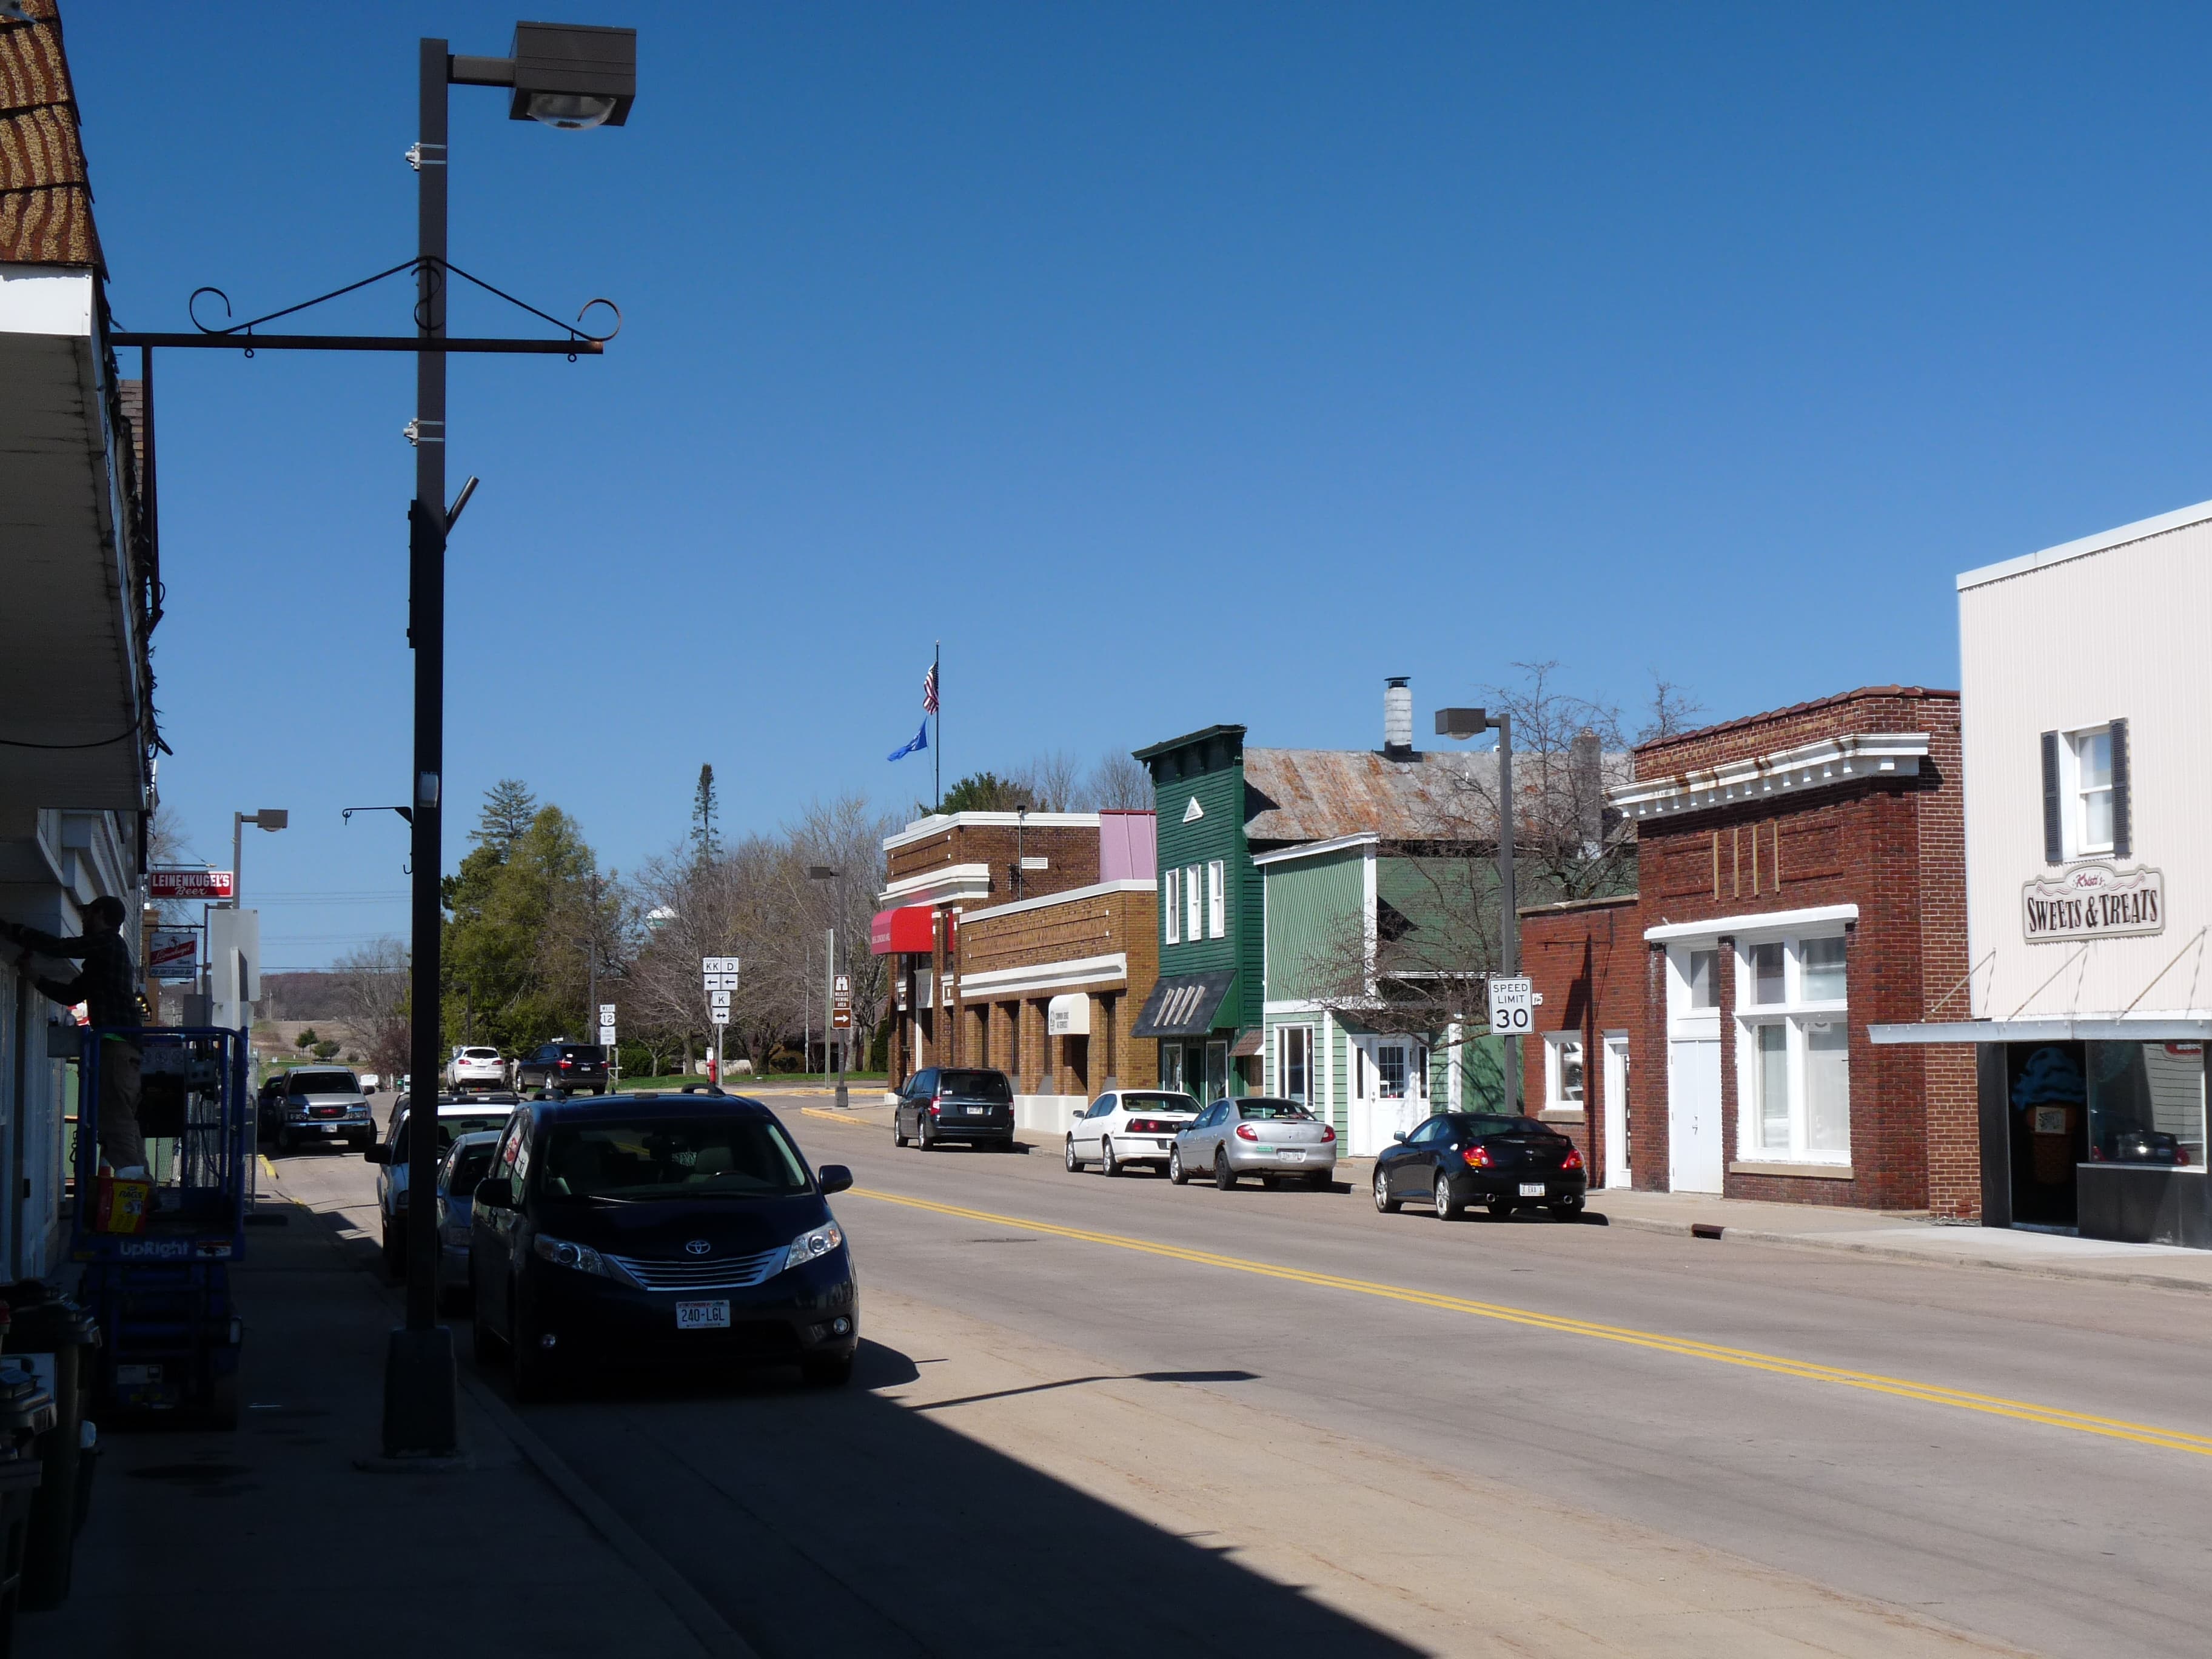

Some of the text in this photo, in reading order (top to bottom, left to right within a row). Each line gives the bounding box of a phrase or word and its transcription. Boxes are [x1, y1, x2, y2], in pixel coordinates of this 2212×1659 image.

[152, 874, 230, 887] LEINENKUGEL'S
[2076, 872, 2105, 888] Kristi's
[175, 886, 207, 895] Beer
[2028, 890, 2158, 933] SWEETS & TREATS
[706, 962, 719, 971] KK
[727, 962, 734, 971] D
[1493, 984, 1528, 993] SPEED
[1498, 994, 1524, 1004] LIMIT
[1496, 1008, 1528, 1028] 30
[119, 1241, 189, 1258] UpRight
[682, 1307, 725, 1322] 240-LGL
